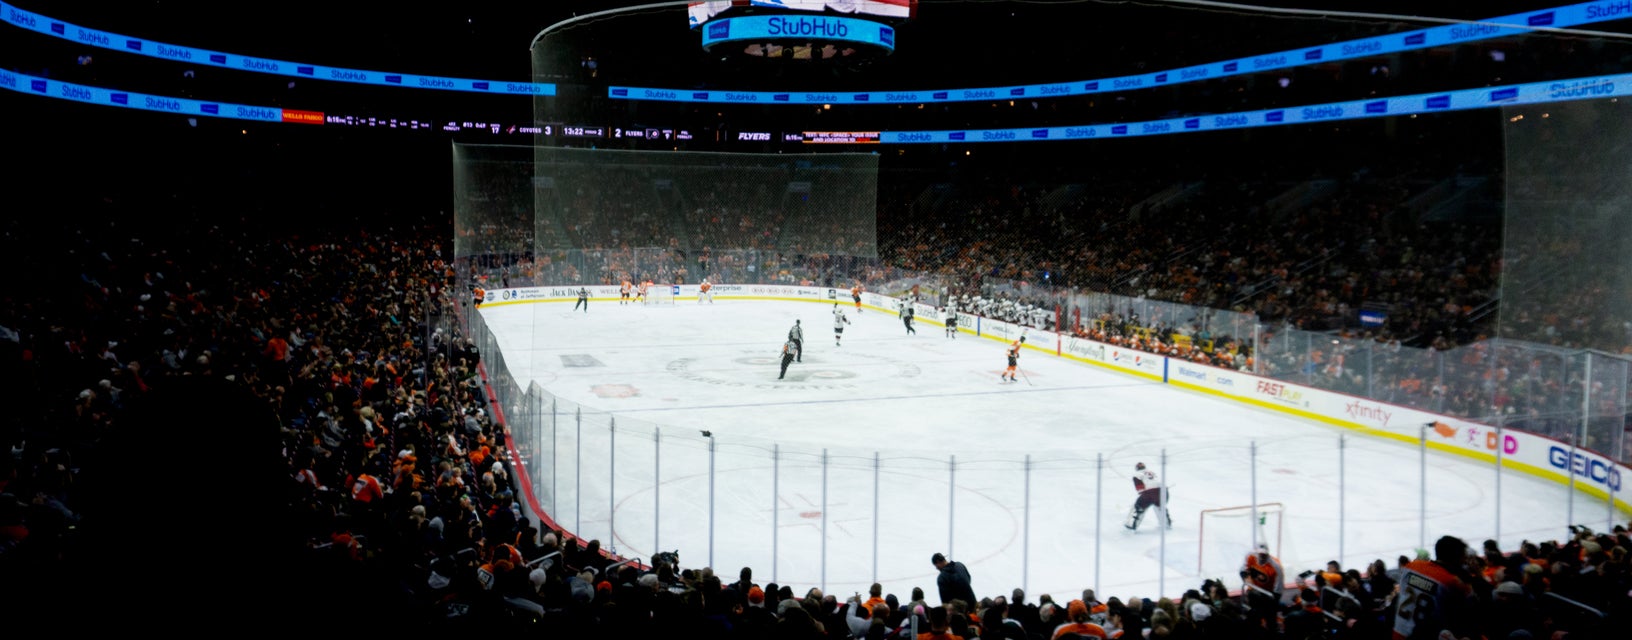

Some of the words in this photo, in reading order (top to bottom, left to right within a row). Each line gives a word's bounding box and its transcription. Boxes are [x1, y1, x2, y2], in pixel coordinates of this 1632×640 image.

[1586, 1, 1632, 19] StubH
[768, 17, 849, 37] StubHub
[1449, 22, 1500, 39] StubHub
[78, 30, 110, 45] StubHub
[157, 45, 192, 60] StubHub
[1341, 40, 1382, 56] StubHub
[243, 59, 279, 72] StubHub
[1253, 54, 1287, 69] StubHub
[331, 69, 367, 81] StubHub
[419, 77, 454, 89] StubHub
[507, 83, 541, 94] StubHub
[61, 84, 92, 100] StubHub
[645, 89, 676, 99] StubHub
[964, 89, 995, 99] StubHub
[1551, 82, 1613, 98] StubHub
[725, 92, 757, 102] StubHub
[806, 92, 837, 102] StubHub
[886, 92, 917, 102] StubHub
[145, 97, 180, 112] StubHub
[237, 106, 275, 120] StubHub
[283, 112, 303, 120] WELLS
[1302, 106, 1343, 120] StubHub
[1214, 114, 1247, 127] StubHub
[545, 126, 551, 135] 3
[563, 127, 583, 135] 13:22
[614, 128, 622, 137] 2
[1065, 127, 1096, 138] StubHub
[1143, 122, 1170, 133] StubHub
[738, 131, 771, 140] FLYERS
[898, 131, 931, 142] StubHub
[983, 131, 1016, 141] StubHub
[550, 288, 566, 297] JACK
[917, 305, 938, 319] StubHub
[1178, 367, 1207, 381] Walmart
[1345, 401, 1392, 426] xfinity
[1549, 445, 1622, 492] GEICO
